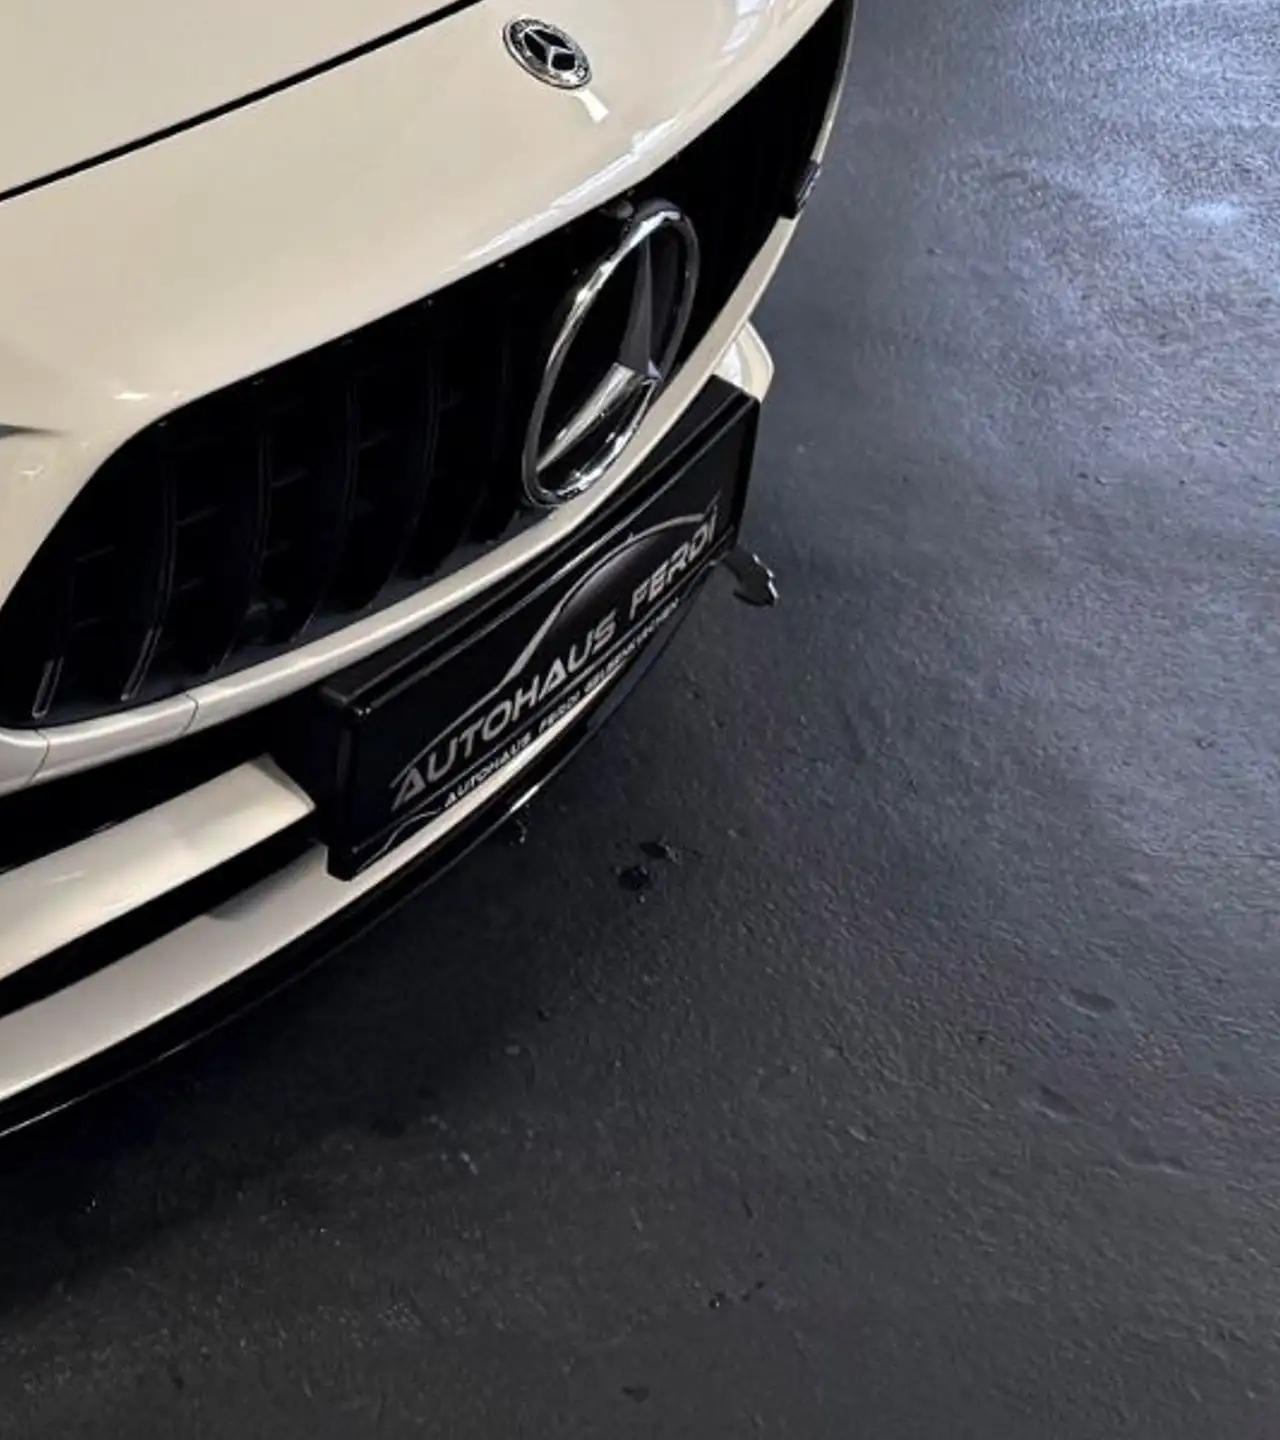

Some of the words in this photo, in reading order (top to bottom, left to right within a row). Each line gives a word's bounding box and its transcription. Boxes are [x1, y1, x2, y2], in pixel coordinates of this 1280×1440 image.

[391, 610, 616, 810] AUTOHAUS
[629, 504, 718, 622] FERDI
[444, 732, 531, 808] AUTOHAUS
